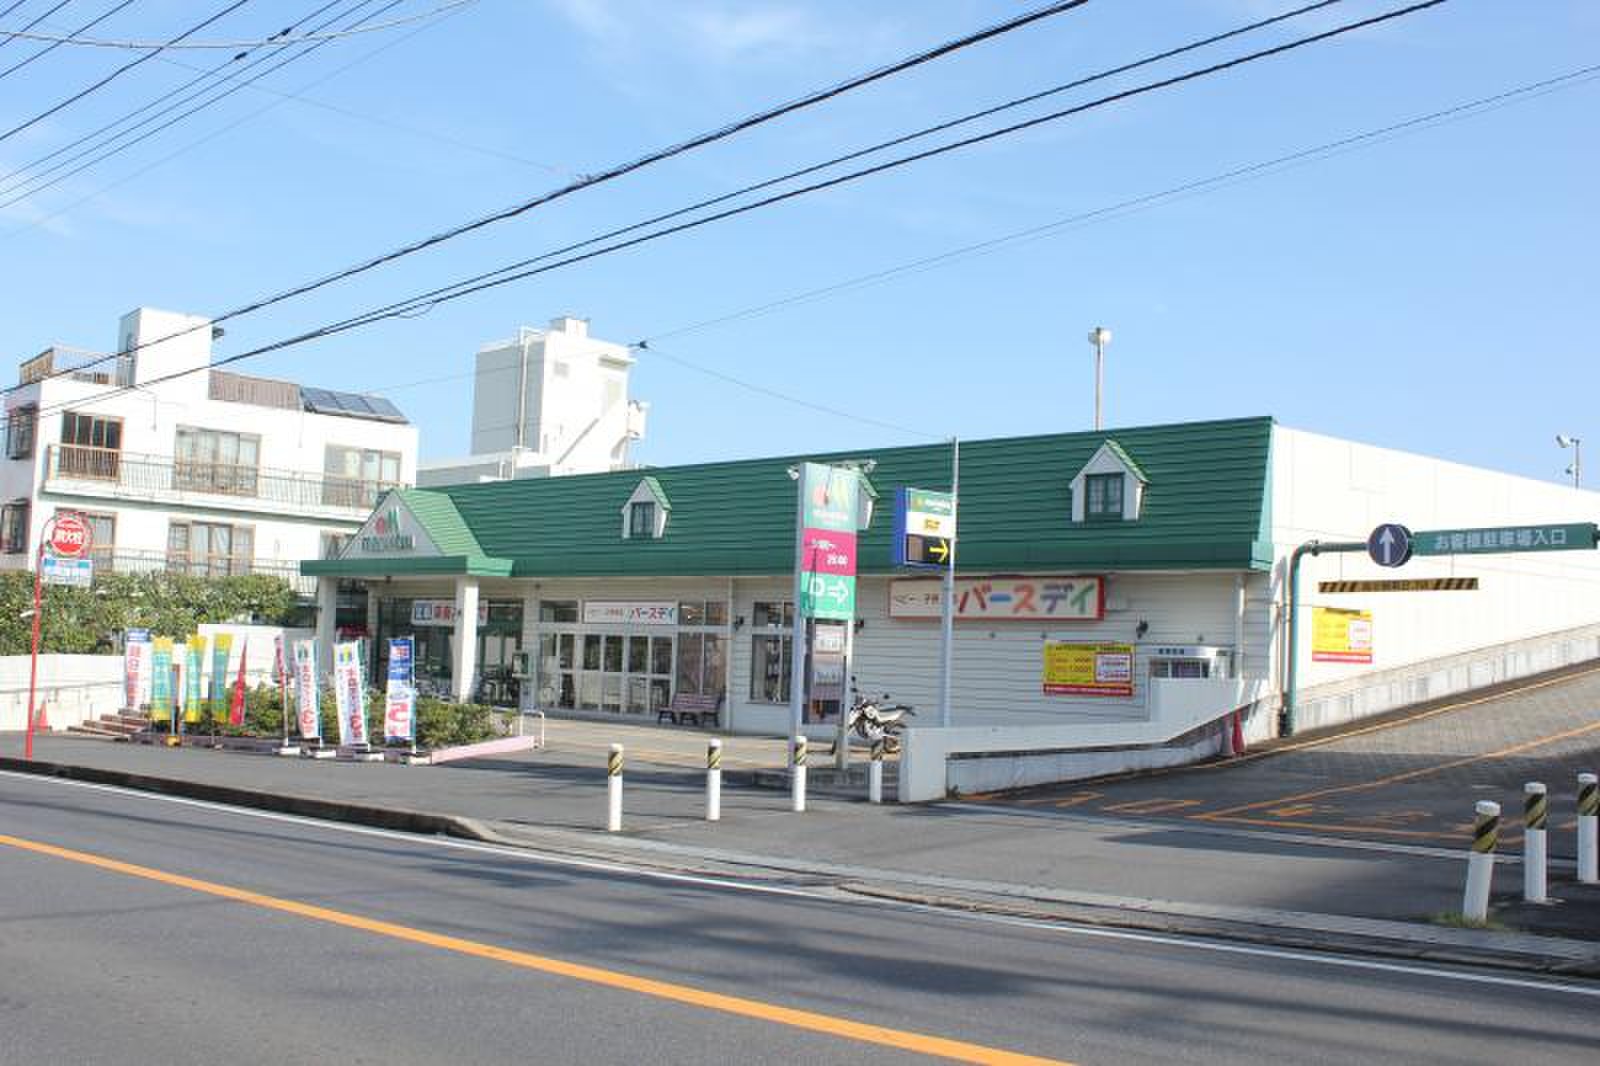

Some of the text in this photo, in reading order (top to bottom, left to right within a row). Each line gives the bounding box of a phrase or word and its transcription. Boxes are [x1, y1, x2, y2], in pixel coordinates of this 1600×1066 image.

[958, 583, 1095, 614] バースデイ
